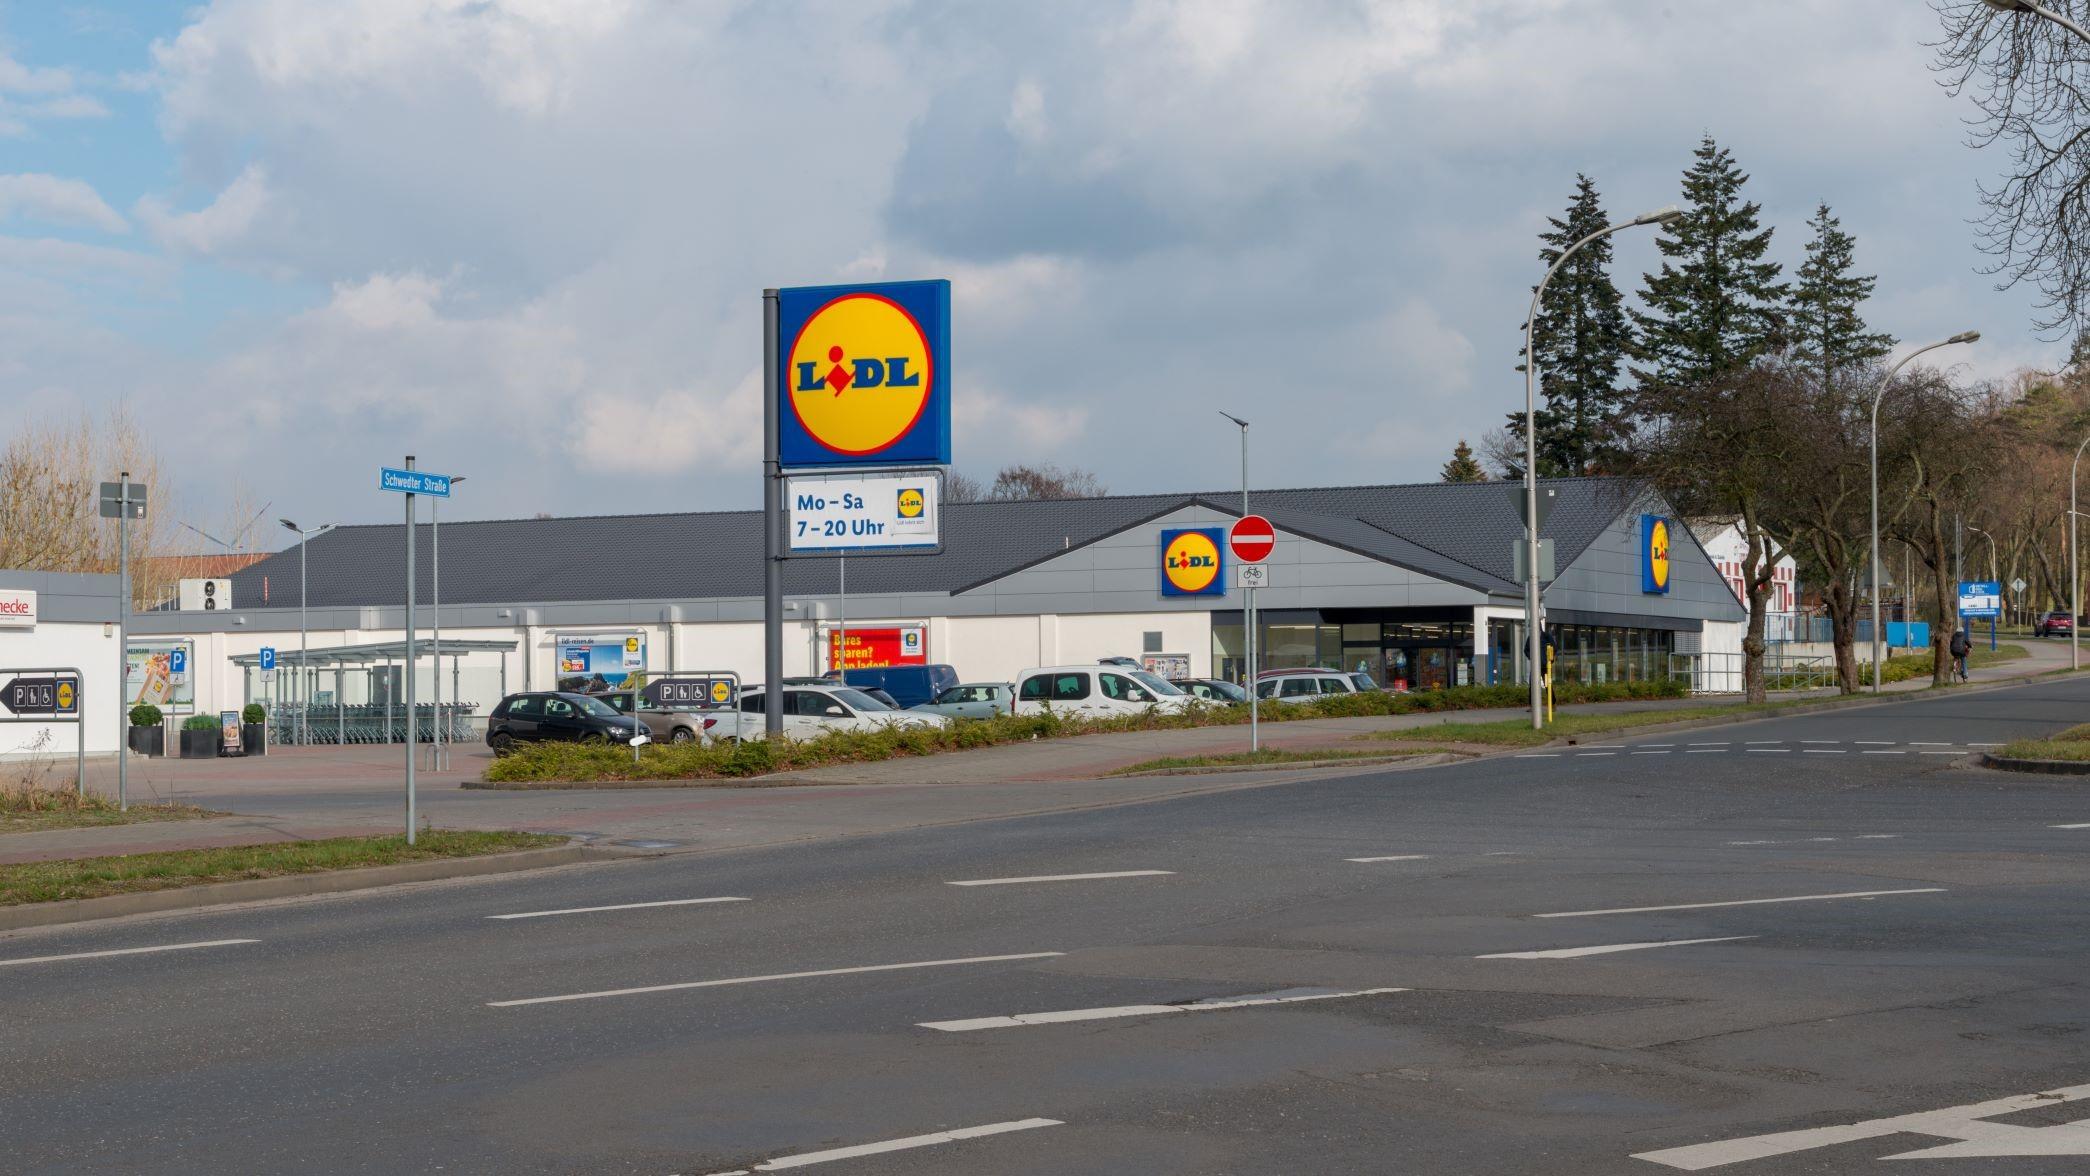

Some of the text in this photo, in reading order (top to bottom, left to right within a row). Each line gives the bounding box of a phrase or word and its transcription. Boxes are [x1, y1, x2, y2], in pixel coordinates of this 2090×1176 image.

[385, 472, 447, 492] Schwedter Straße
[797, 494, 825, 511] Mo
[843, 493, 864, 510] Sa
[797, 521, 807, 537] 7
[824, 520, 847, 536] 20
[852, 519, 885, 535] Uhr
[834, 635, 861, 646] Bres
